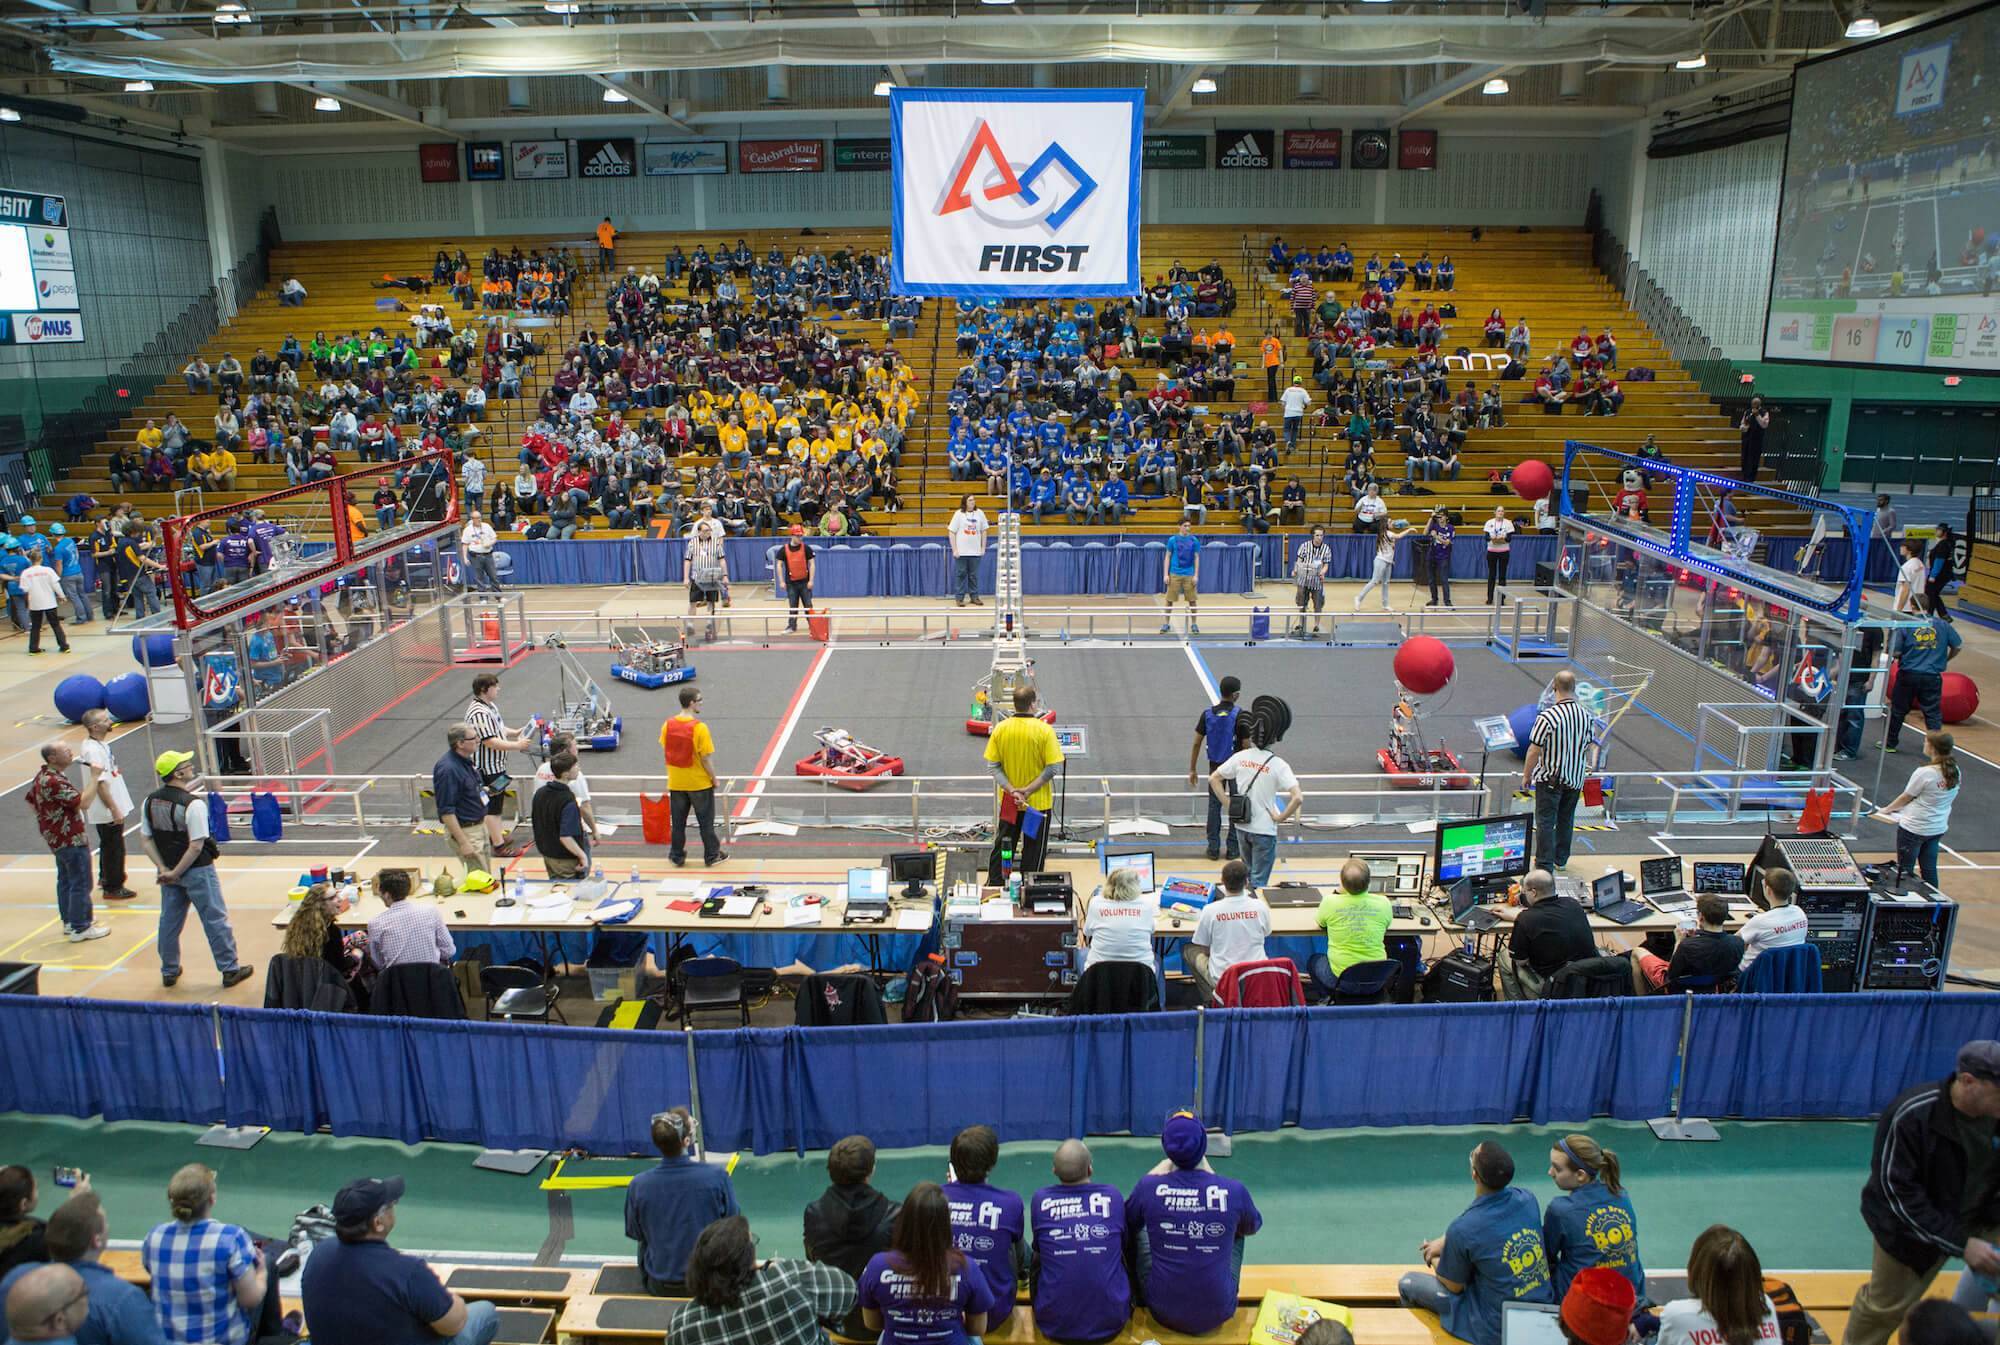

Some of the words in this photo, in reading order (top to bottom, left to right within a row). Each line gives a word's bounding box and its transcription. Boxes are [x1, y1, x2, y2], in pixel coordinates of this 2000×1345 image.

[843, 150, 891, 161] enterp
[1221, 155, 1268, 167] adidas
[584, 164, 630, 176] adidas
[0, 195, 32, 218] SITY
[979, 245, 1089, 272] FIRST
[1847, 328, 1862, 346] 16
[1896, 330, 1912, 348] 70
[663, 671, 683, 683] 4237
[1418, 777, 1448, 786] 385
[1099, 908, 1141, 918] VOLUNTEER
[1216, 911, 1258, 921] VOLUNTEER
[1774, 920, 1808, 934] VOLUNTEE
[1592, 1223, 1633, 1249] BOB
[1508, 1243, 1543, 1275] BOB
[1688, 1321, 1777, 1345] VOLER
